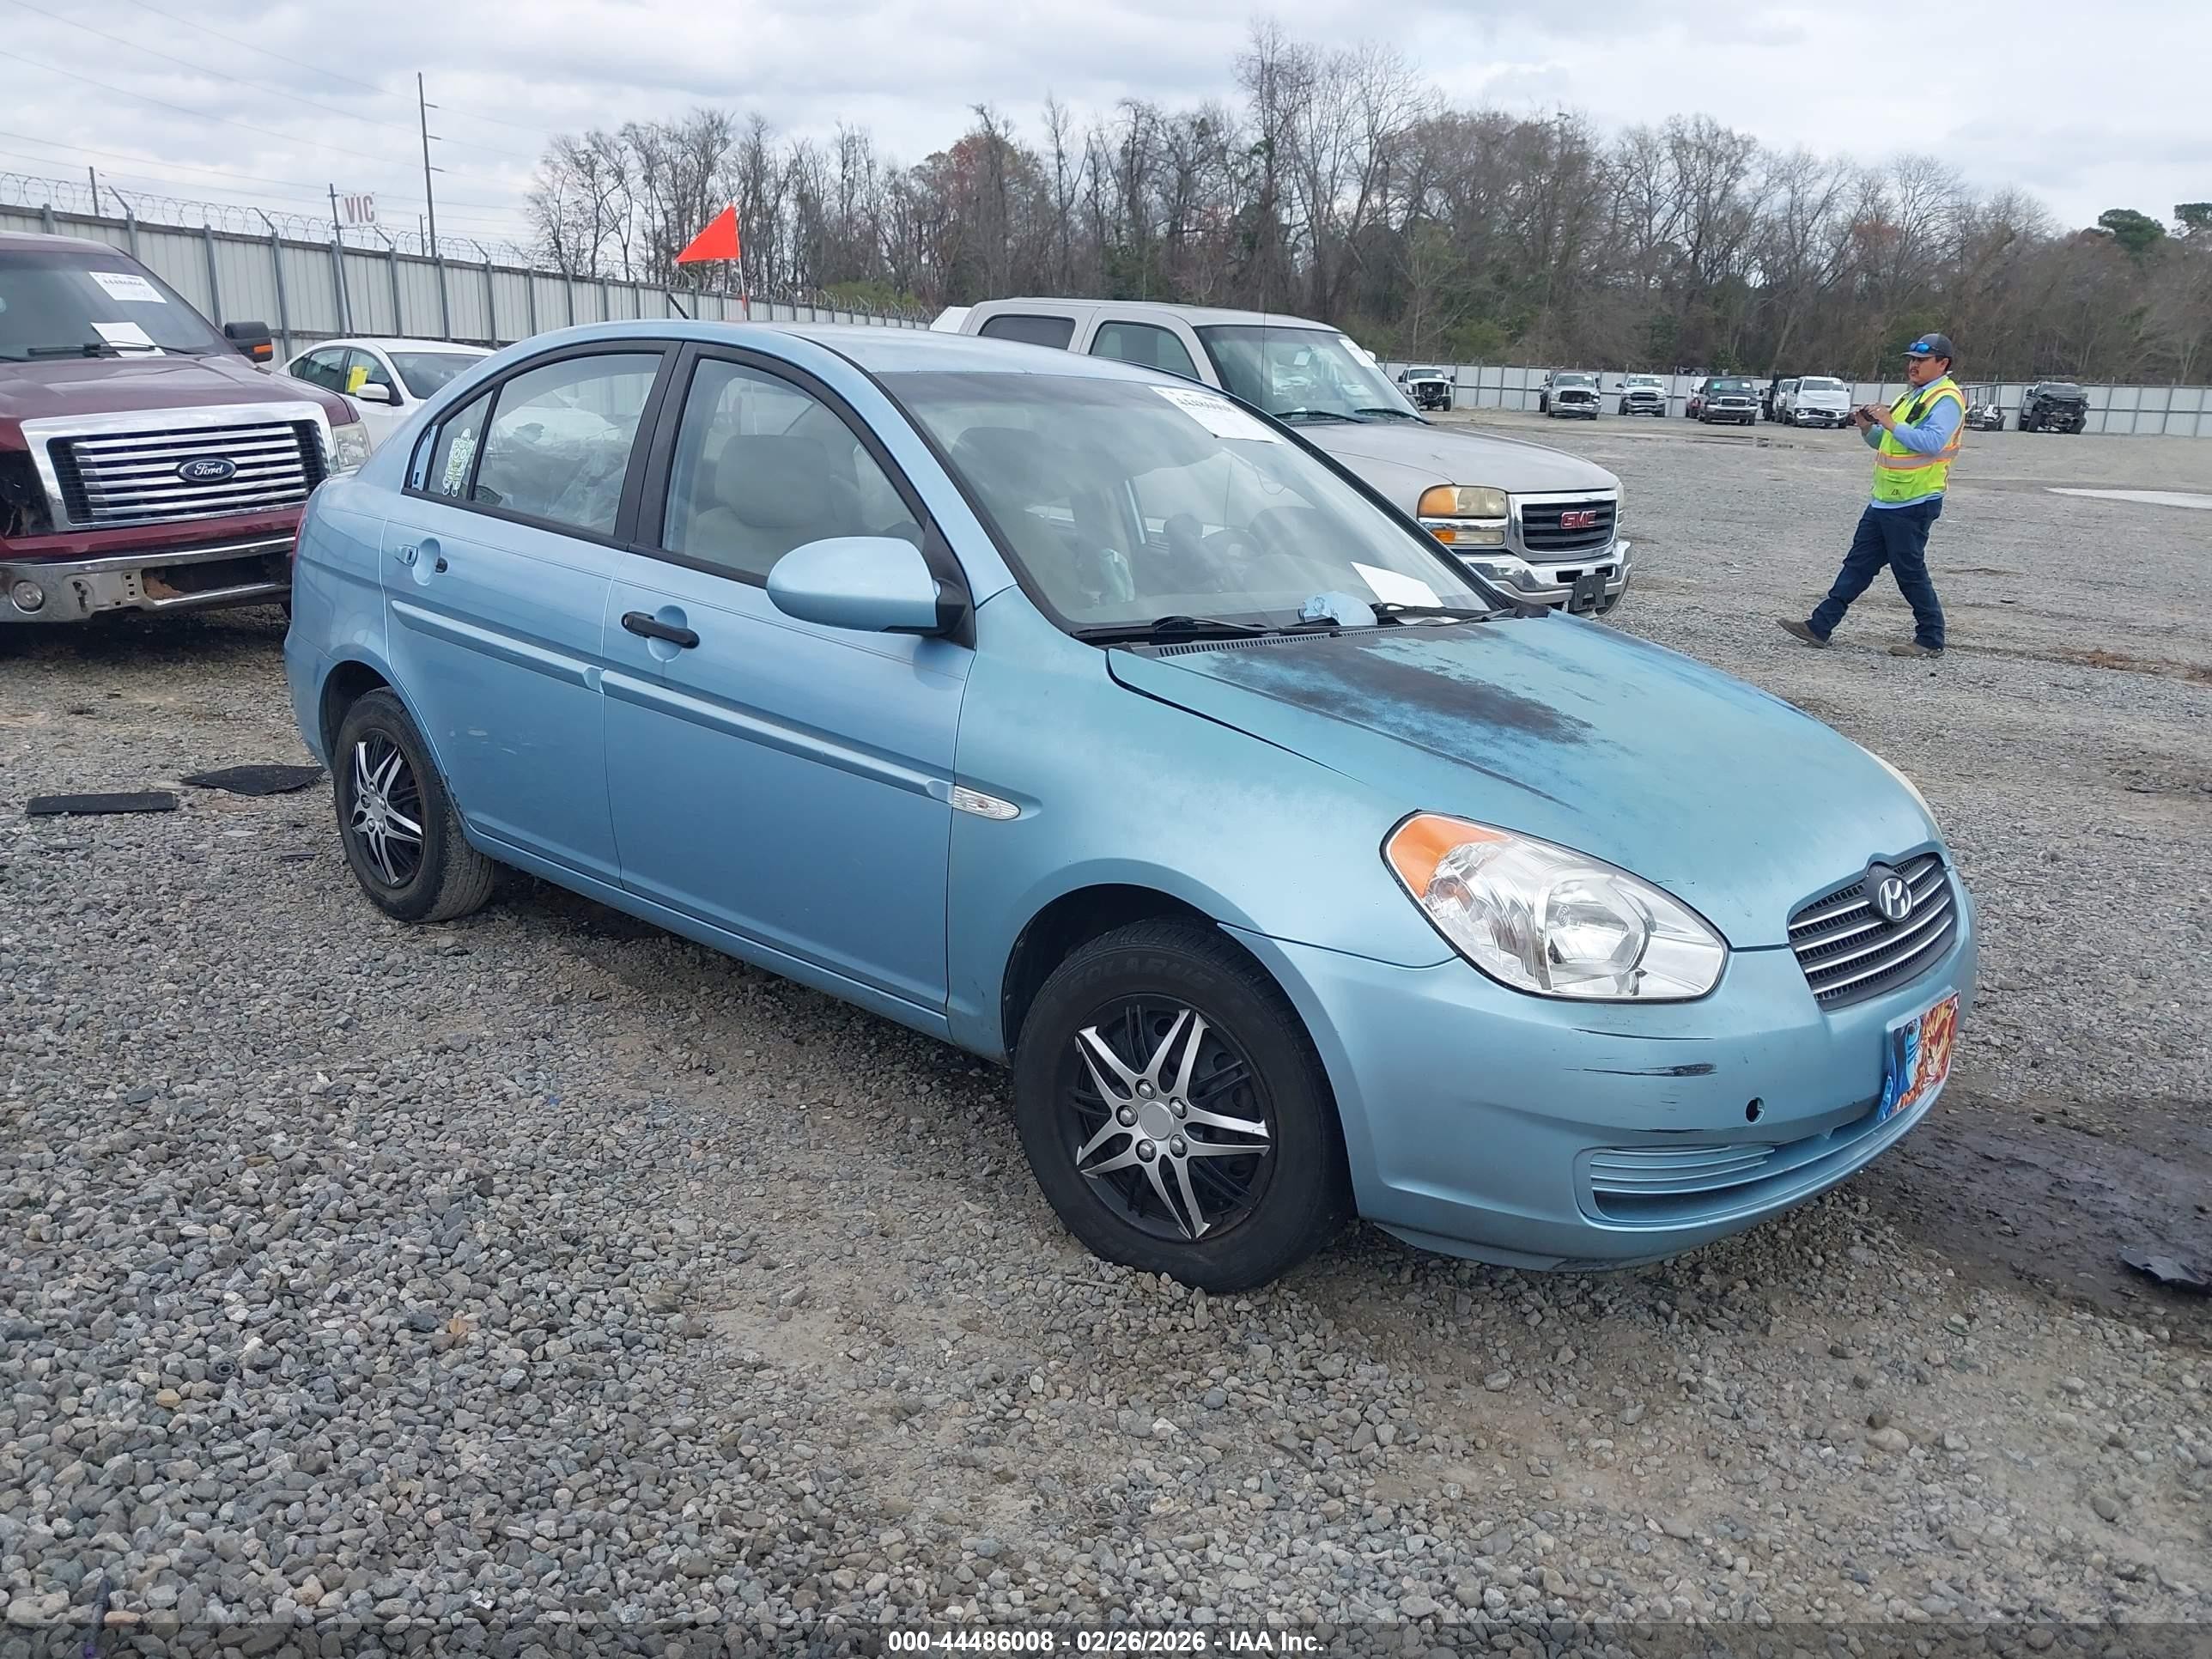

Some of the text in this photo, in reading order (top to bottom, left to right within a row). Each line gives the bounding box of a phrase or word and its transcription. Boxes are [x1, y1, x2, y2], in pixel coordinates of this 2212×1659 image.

[344, 195, 375, 223] VIC
[194, 462, 224, 476] Ford
[1560, 511, 1596, 529] GMC
